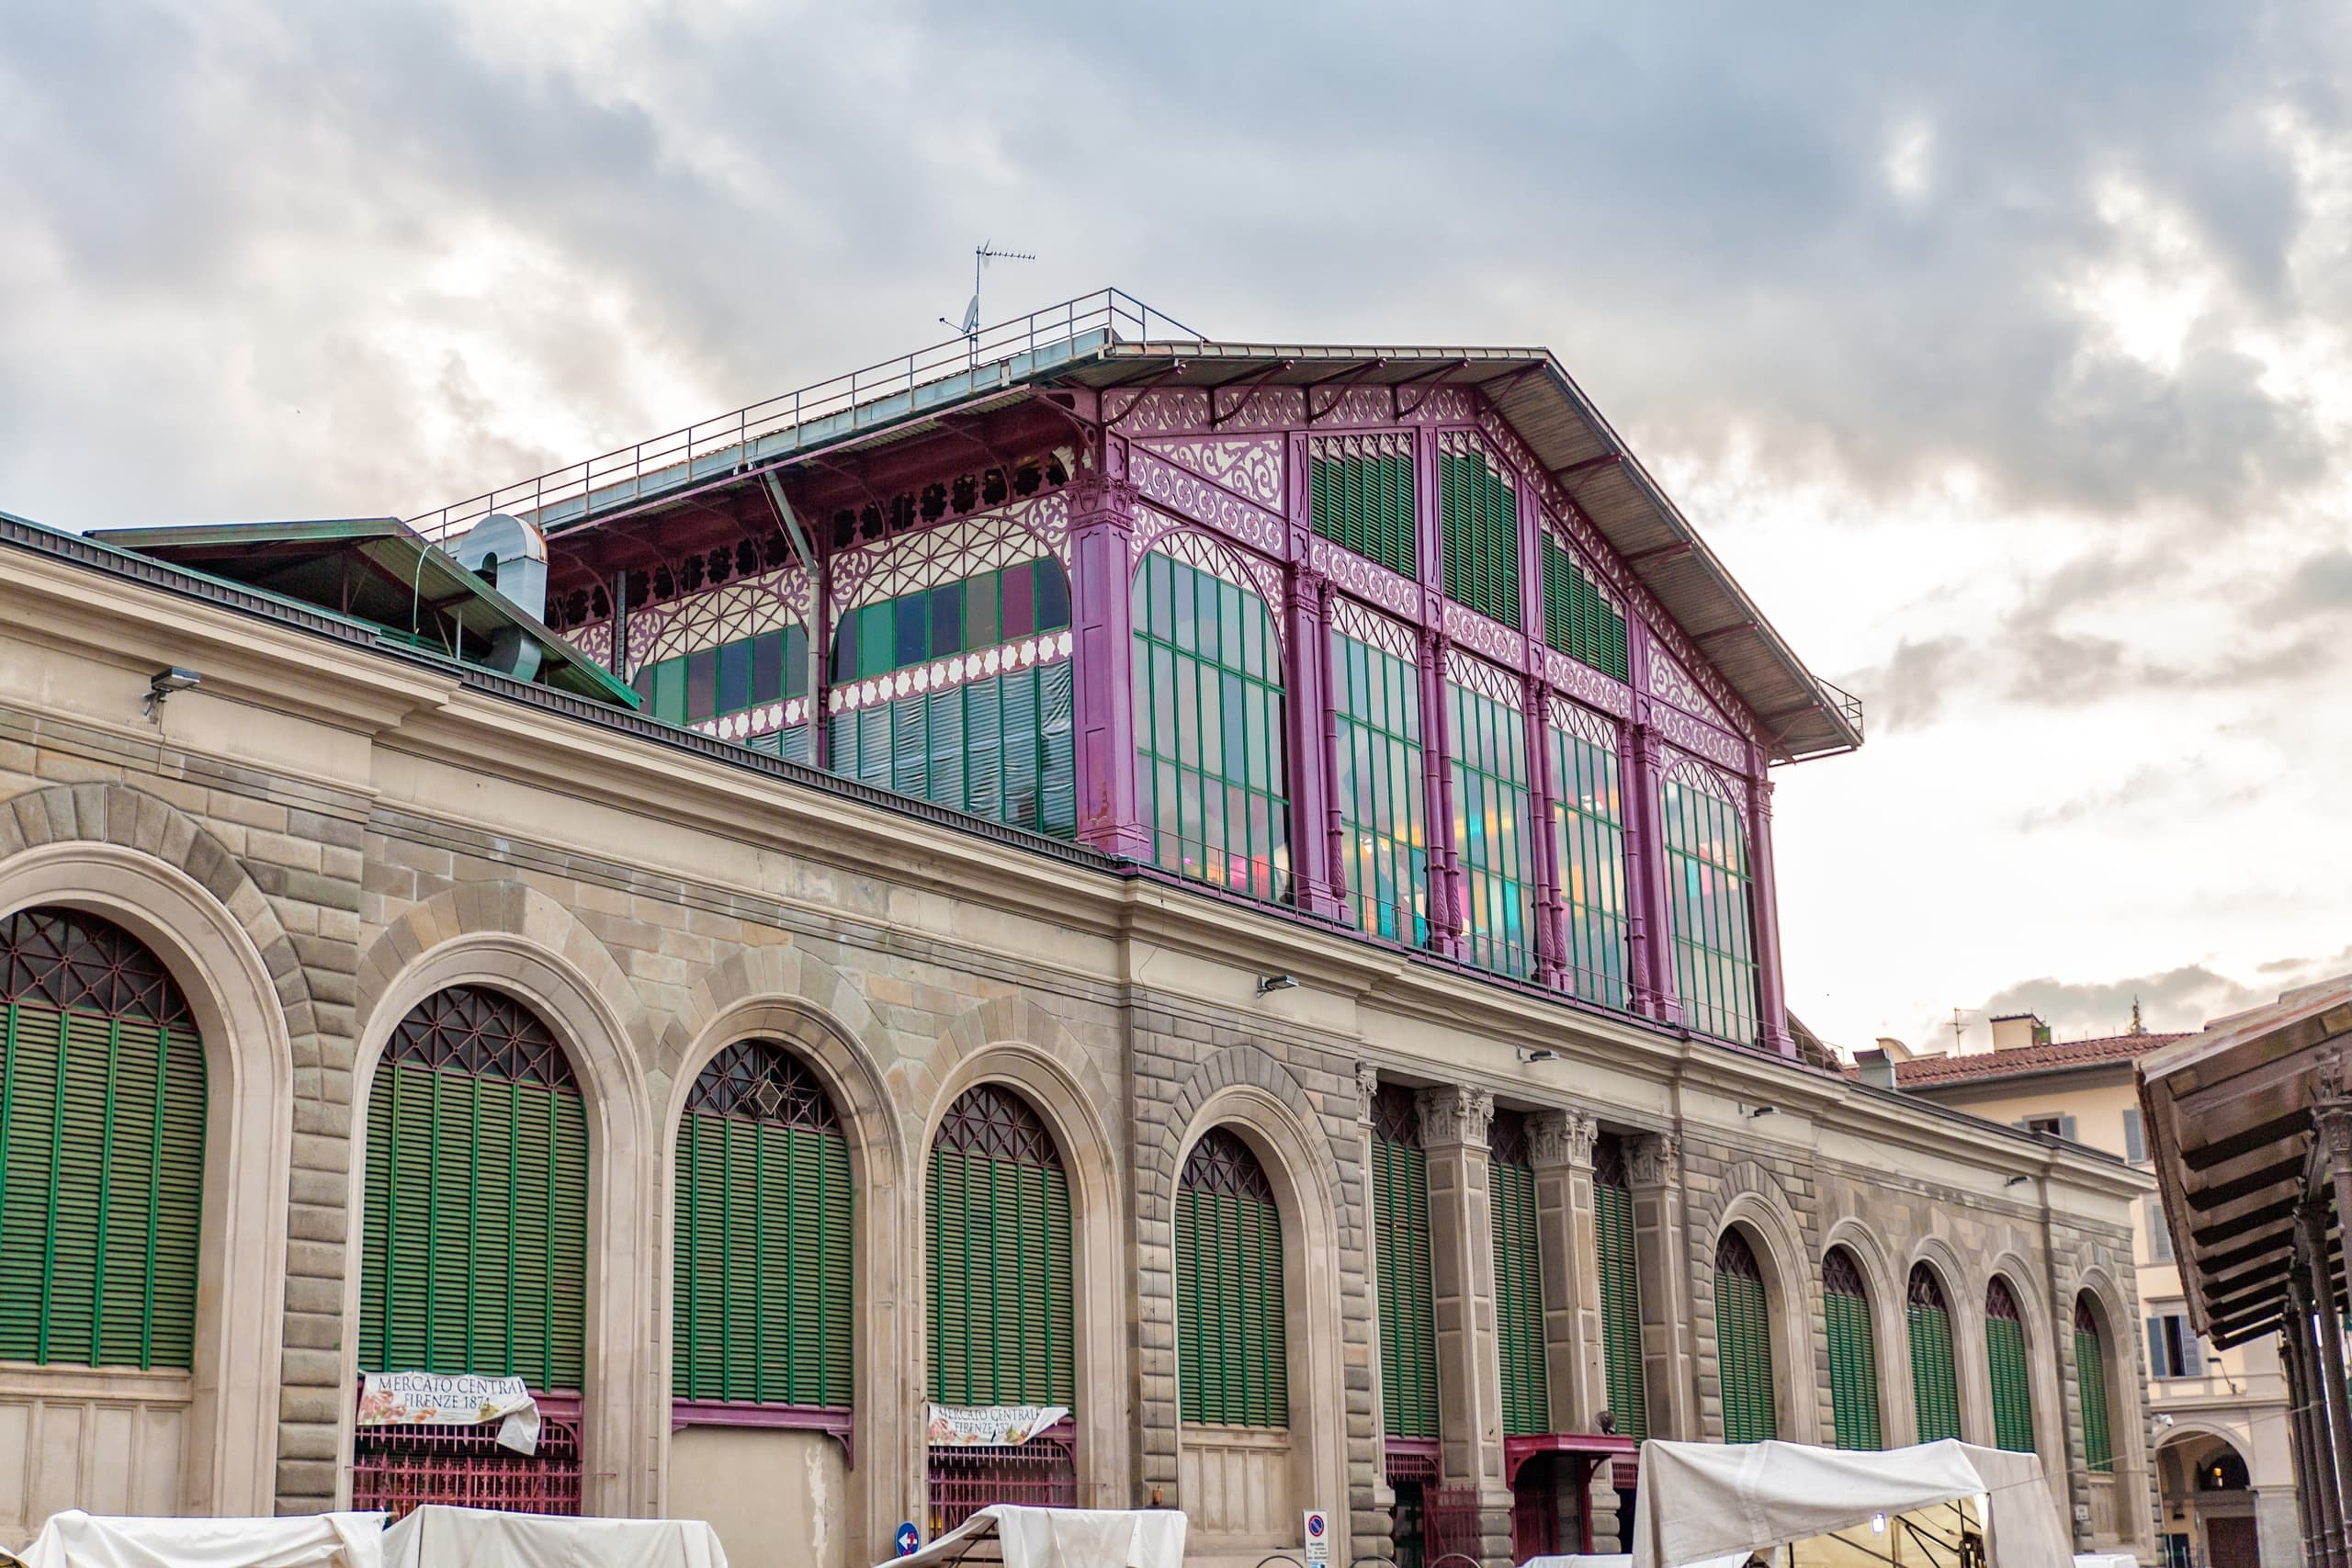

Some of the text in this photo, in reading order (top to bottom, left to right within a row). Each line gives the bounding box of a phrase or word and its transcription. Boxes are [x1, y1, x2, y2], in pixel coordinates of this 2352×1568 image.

[379, 1376, 452, 1393] MERCATO
[404, 1393, 491, 1409] FIRENZE 1874
[939, 1406, 988, 1420] MERCATO
[956, 1422, 992, 1433] FIRENZE
